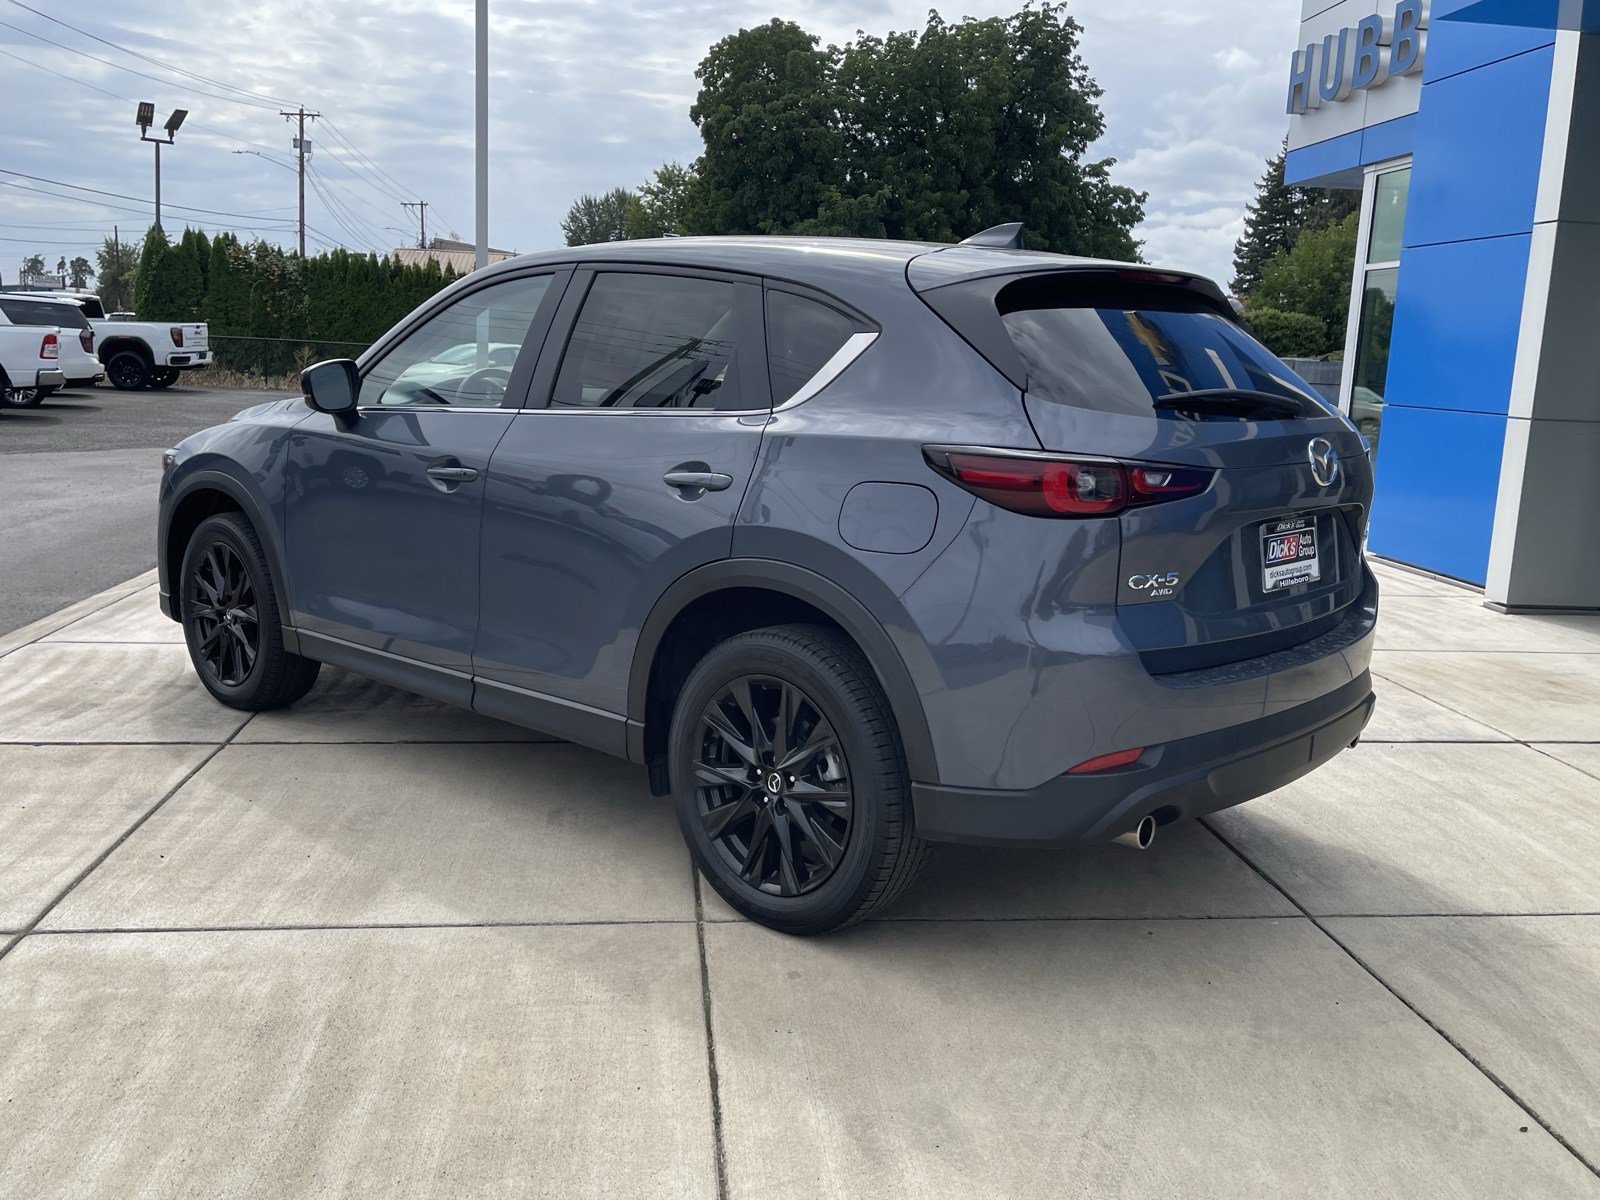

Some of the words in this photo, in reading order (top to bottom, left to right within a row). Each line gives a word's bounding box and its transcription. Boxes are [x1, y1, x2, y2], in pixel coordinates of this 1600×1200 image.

[1299, 534, 1312, 545] Auto
[1268, 539, 1296, 559] Dick's
[1298, 545, 1315, 557] Group
[1269, 564, 1313, 579] dicksautogroup.com
[1128, 572, 1179, 590] CX-5
[1280, 576, 1309, 587] Hillsboro
[1150, 588, 1173, 597] AWD
